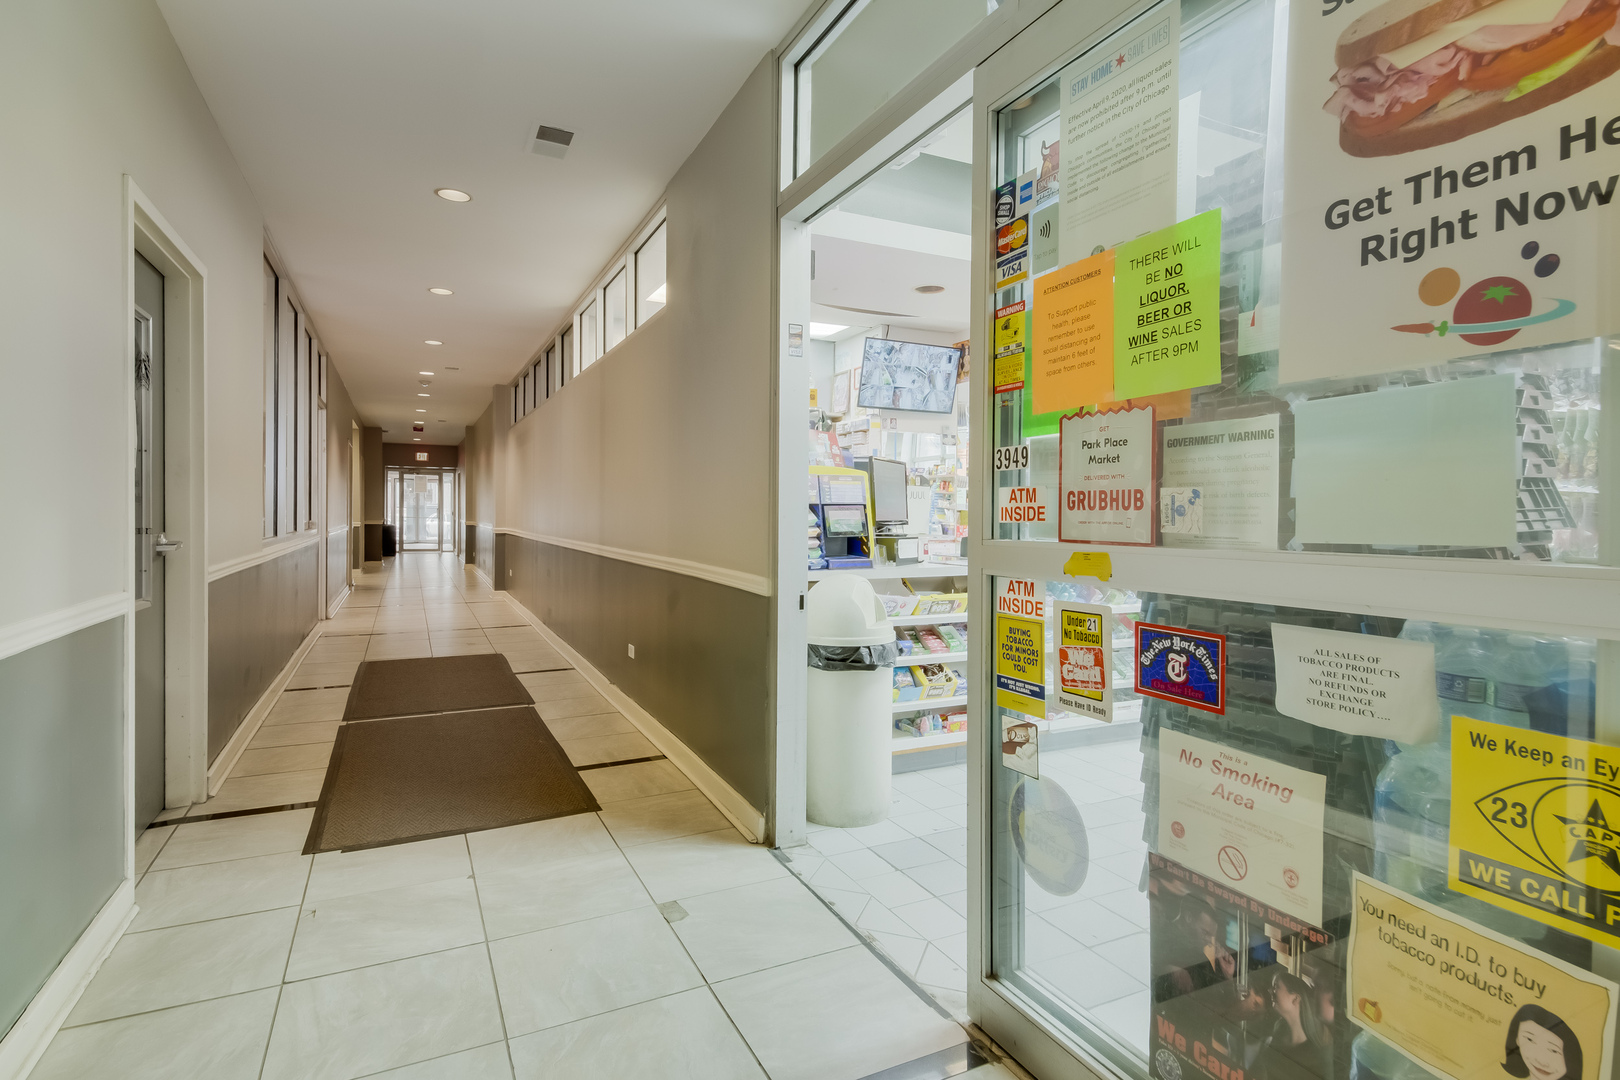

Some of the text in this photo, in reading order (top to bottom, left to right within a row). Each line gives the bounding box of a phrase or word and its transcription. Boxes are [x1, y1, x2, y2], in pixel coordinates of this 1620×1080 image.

[1072, 25, 1167, 97] STAY HOME SAVE LIVES
[1068, 107, 1091, 124] Effective
[1092, 97, 1105, 111] April
[1111, 84, 1127, 99] 2020,
[1135, 70, 1154, 87] liquor
[1154, 59, 1172, 74] sales
[1068, 125, 1077, 134] are
[1079, 119, 1089, 129] now
[1090, 102, 1119, 124] prohibited
[1120, 91, 1134, 105] after
[1136, 87, 1140, 96] 9
[1157, 69, 1171, 84] until
[1067, 131, 1086, 145] further
[1087, 122, 1104, 136] notice
[1111, 111, 1121, 121] the
[1122, 104, 1134, 115] City
[1135, 97, 1142, 107] of
[1324, 186, 1392, 230] Get
[1404, 144, 1537, 206] Them
[1360, 174, 1620, 267] Right Now
[998, 226, 1027, 247] MasterCard
[1129, 236, 1202, 271] THERE WILL
[1002, 261, 1022, 279] VISA
[1145, 262, 1183, 285] BE NO
[1043, 269, 1102, 295] ATTENTION CUSTOMERS
[1139, 282, 1190, 307] LIQUOR,
[997, 302, 1024, 318] WARNING
[1048, 299, 1097, 320] To Support public
[1071, 314, 1091, 326] please
[1137, 300, 1192, 327] BEER OR
[1047, 329, 1076, 343] remember
[1084, 324, 1095, 332] use
[1128, 318, 1202, 348] WINE SALES
[1043, 333, 1101, 356] social distancing and
[1048, 346, 1096, 365] maintain 6 feet of
[1131, 340, 1199, 367] AFTER 9PM
[1046, 367, 1063, 377] space
[1063, 364, 1076, 373] from
[1081, 437, 1129, 450] Park Place
[1167, 429, 1275, 449] GOVERNMENT WARNING
[995, 445, 1029, 470] 3949
[1088, 453, 1121, 465] Market
[909, 491, 926, 500] JUUL
[1008, 487, 1037, 504] ATM
[1067, 488, 1145, 511] GRUBHUB
[1000, 506, 1046, 523] INSIDE
[1007, 579, 1035, 598] ATM
[999, 599, 1044, 617] INSIDE
[1008, 626, 1031, 638] BUYING
[1066, 615, 1098, 631] Under 21
[1005, 634, 1034, 648] TOBACCO
[1063, 628, 1100, 644] No Tobacco
[1002, 643, 1039, 658] FOR MINORS
[1002, 652, 1039, 667] COULD COST
[1140, 636, 1218, 680] The New York Times
[1313, 648, 1382, 665] ALL SALES OF
[1012, 663, 1028, 674] YOU.
[1167, 652, 1187, 682] T
[1297, 655, 1401, 679] TOBACCO PRODUCTS
[1319, 670, 1374, 686] ARE FINAL.
[1153, 680, 1204, 699] On Sale Here
[1308, 677, 1387, 699] NO REFUNDS OR
[1319, 689, 1375, 708] EXCHANGE
[1059, 696, 1106, 718] Please Have ID Ready
[1306, 697, 1336, 710] STORE
[1219, 752, 1233, 762] This
[1235, 756, 1241, 764] is
[1468, 730, 1620, 782] We Keep an Ey
[1178, 748, 1294, 804] No Smoking
[1211, 783, 1255, 811] Area
[1491, 796, 1528, 829] 23
[1151, 854, 1164, 869] We
[1167, 861, 1190, 881] Can't
[1192, 873, 1205, 888] Be
[1208, 883, 1247, 908] Swayed
[1250, 899, 1265, 918] By
[1267, 908, 1329, 946] Underage!
[1468, 859, 1595, 920] WE CALL
[1359, 895, 1547, 1000] You need an I.D. to buy
[1378, 926, 1518, 1008] tobacco products.
[1156, 1014, 1187, 1053] We
